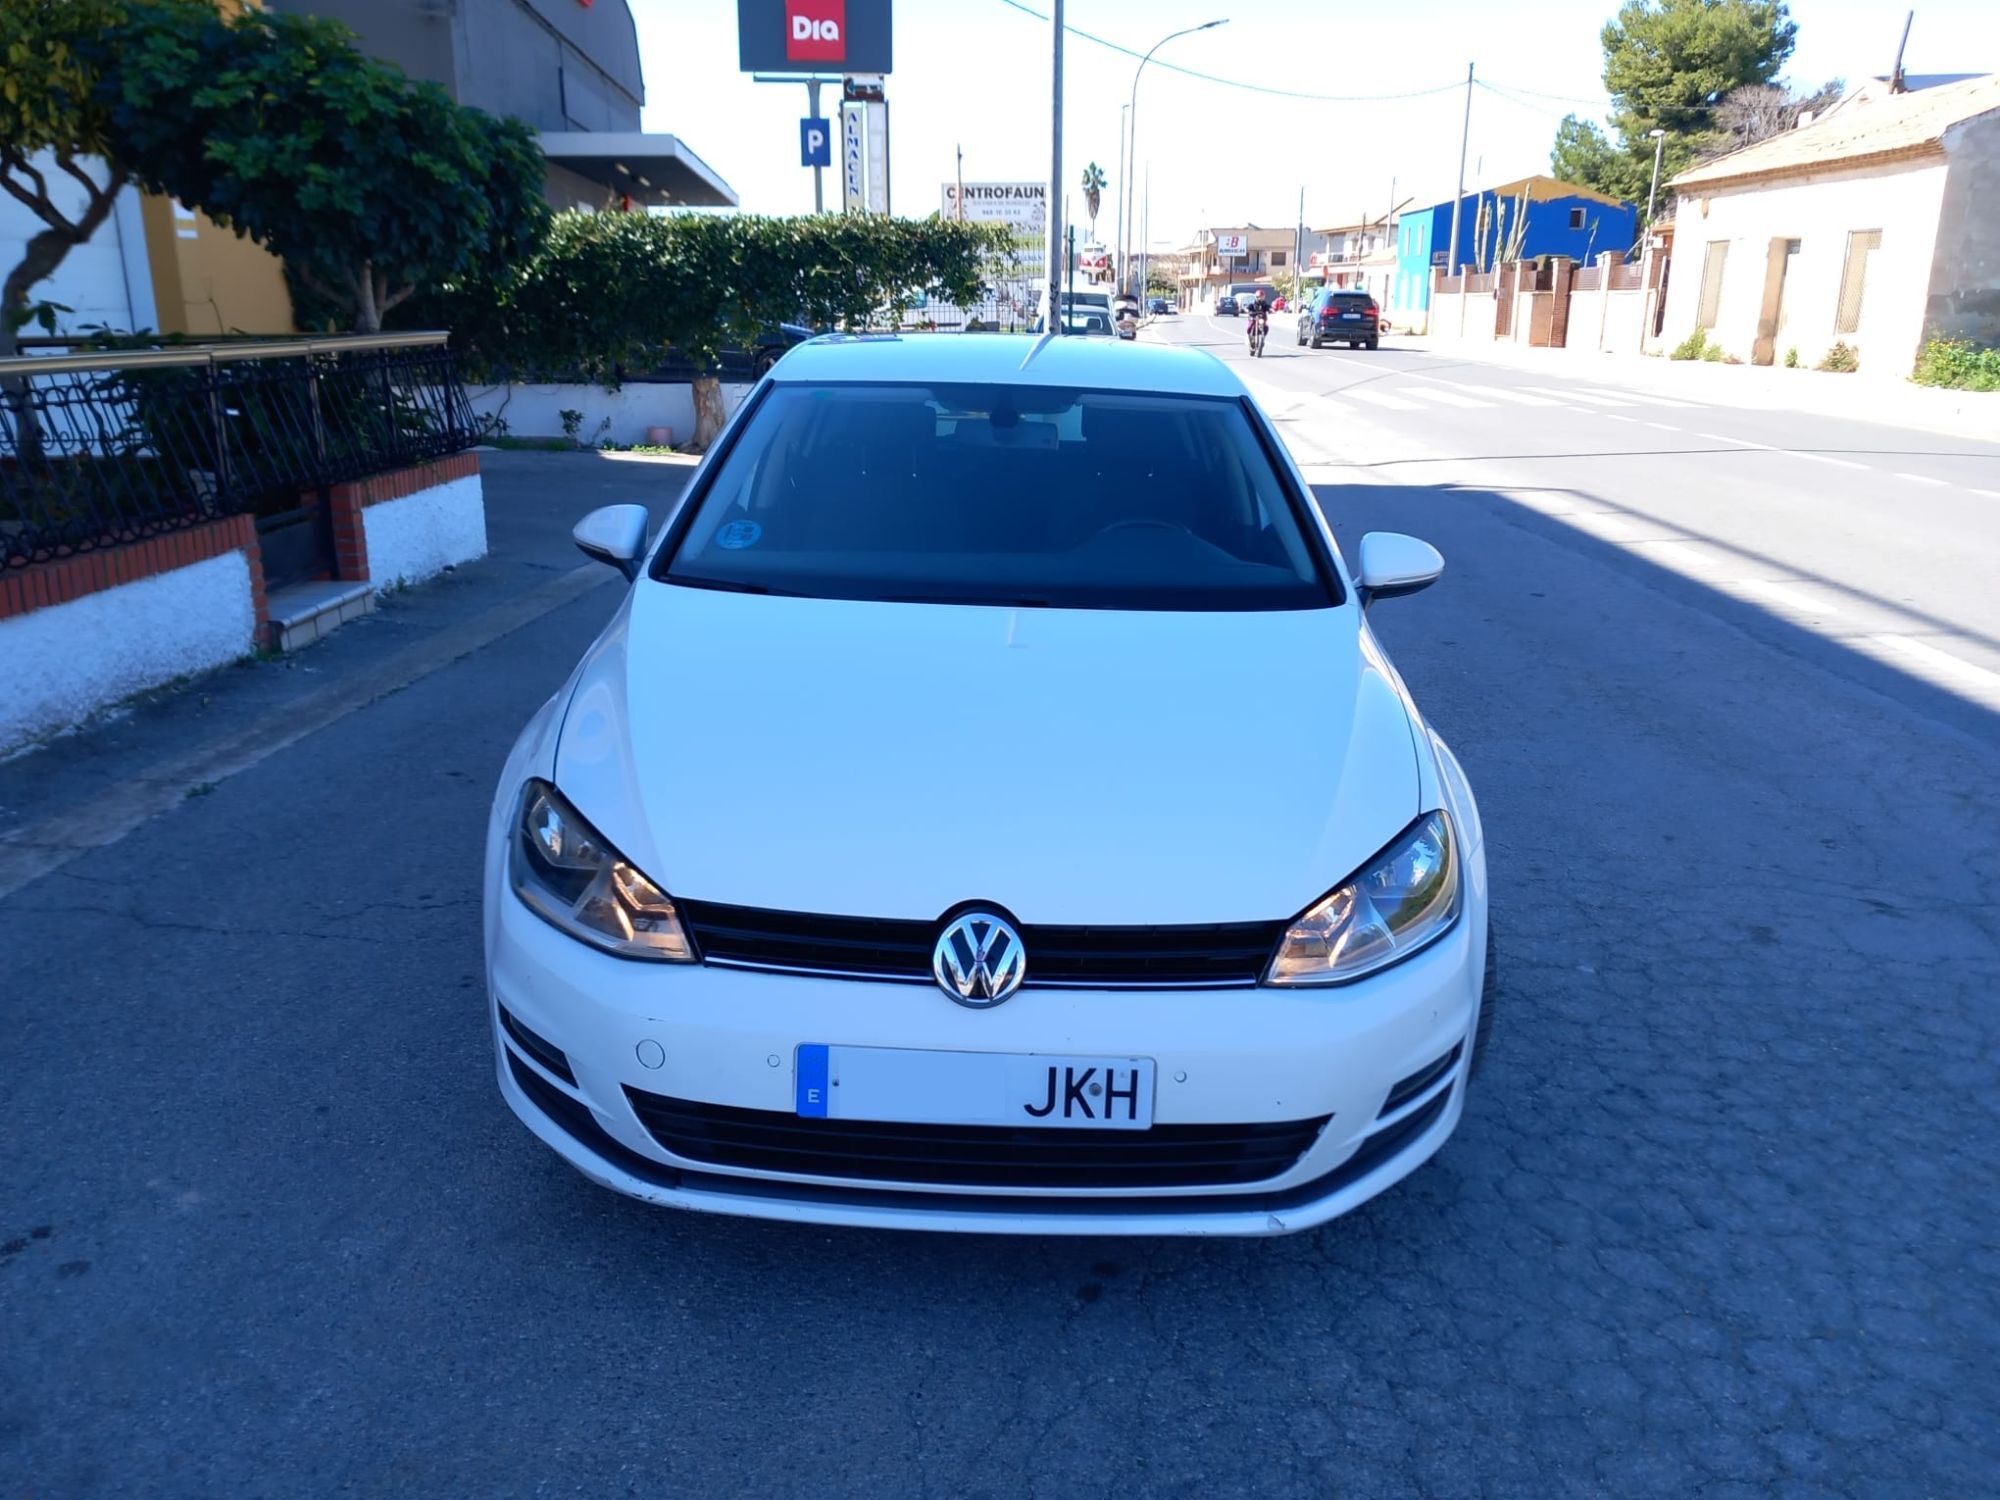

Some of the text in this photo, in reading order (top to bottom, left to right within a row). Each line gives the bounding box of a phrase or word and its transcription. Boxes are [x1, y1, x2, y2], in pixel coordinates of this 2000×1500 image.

[808, 129, 824, 154] P
[807, 1088, 821, 1103] E
[1023, 1066, 1139, 1120] JKH
